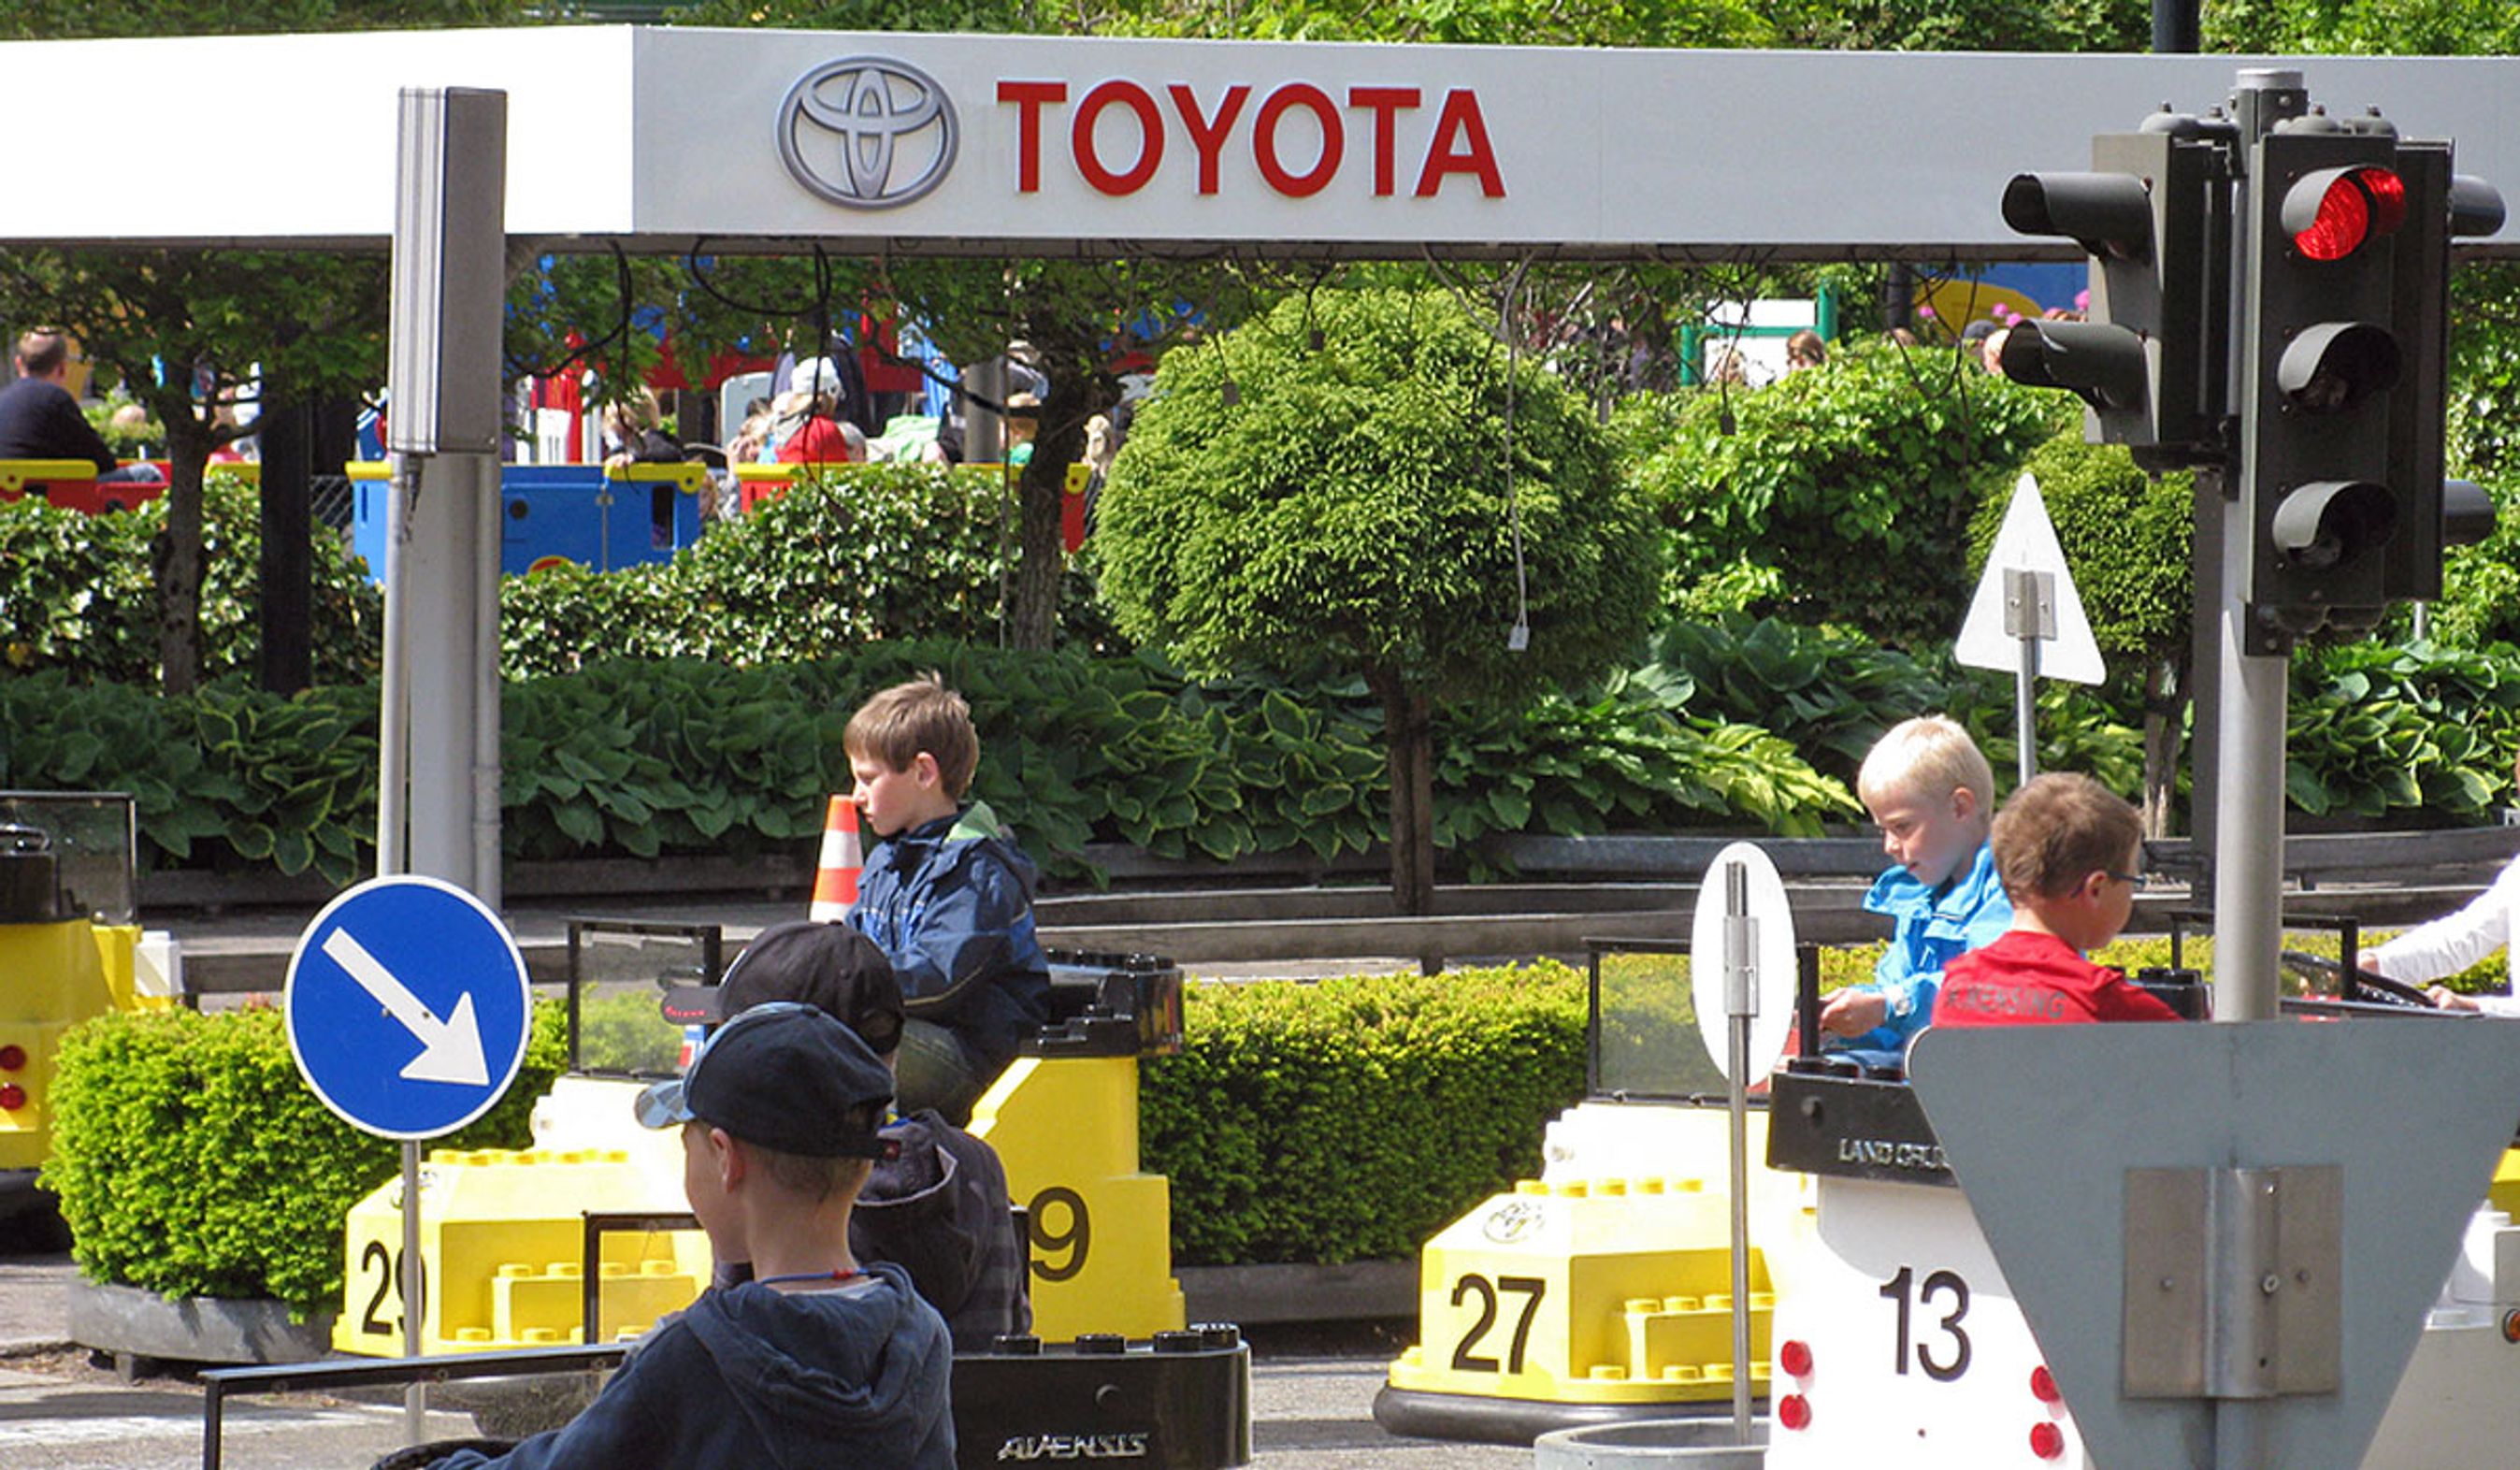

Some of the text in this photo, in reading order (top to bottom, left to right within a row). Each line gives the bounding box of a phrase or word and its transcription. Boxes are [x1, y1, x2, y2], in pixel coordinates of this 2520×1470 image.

[997, 79, 1507, 198] TOYOTA
[1838, 1138, 1894, 1165] LAND
[1450, 1272, 1546, 1375] 27
[1879, 1265, 1972, 1383] 13
[997, 1433, 1149, 1462] AVENSIS
